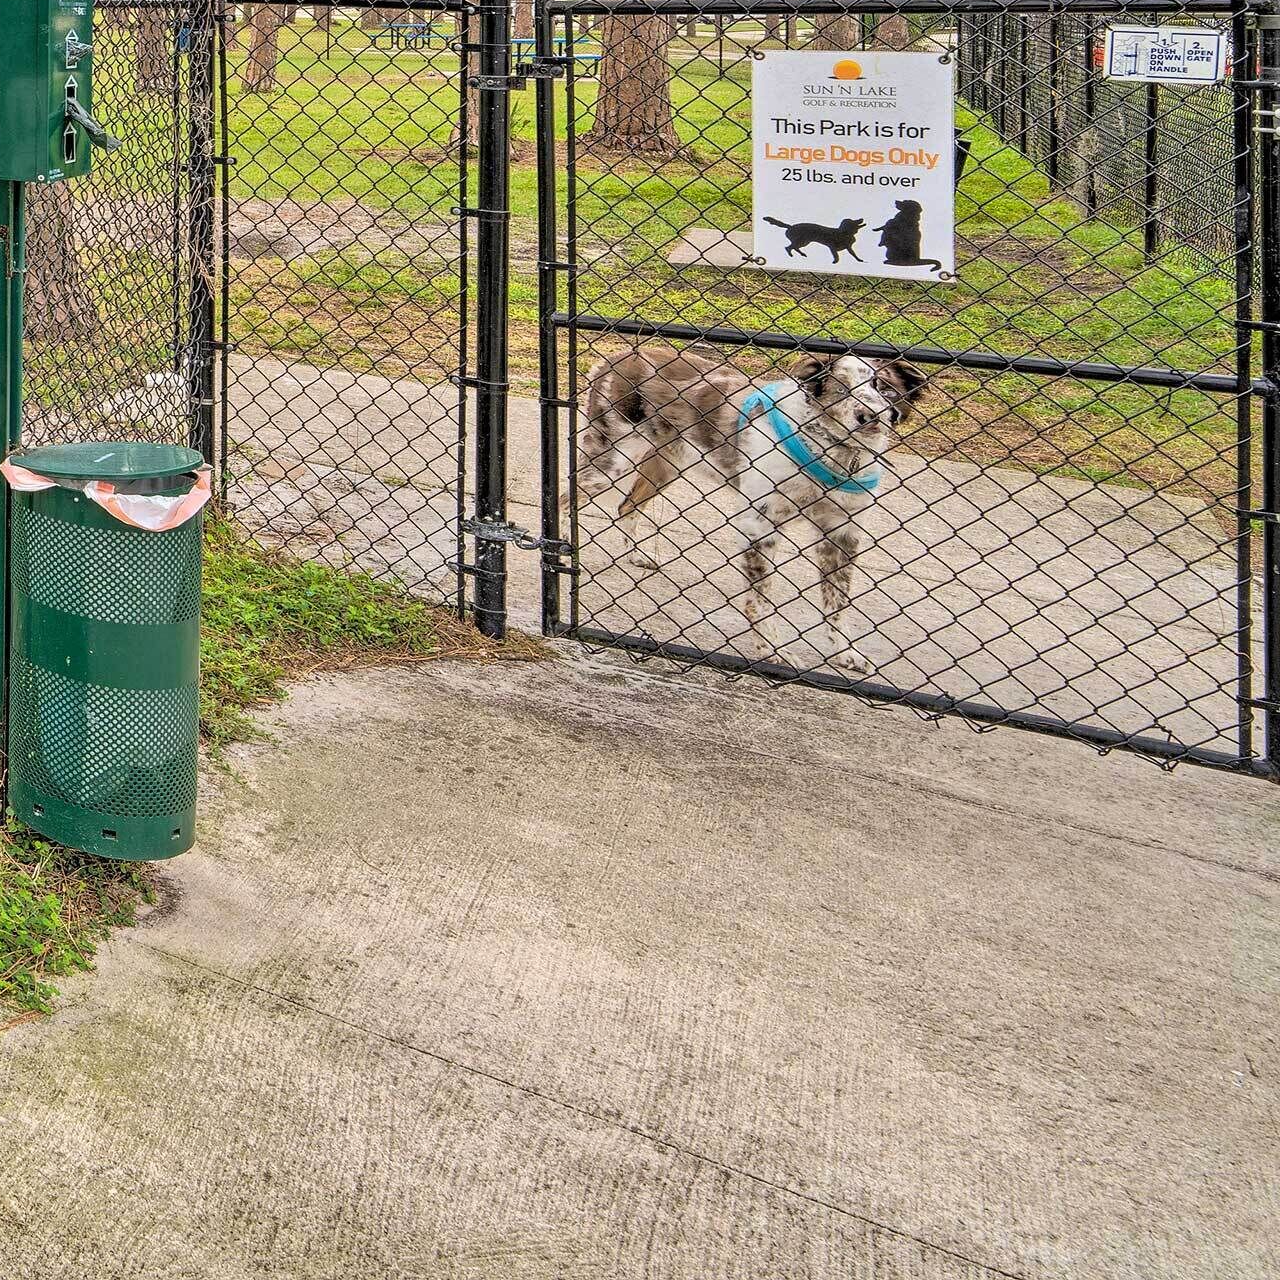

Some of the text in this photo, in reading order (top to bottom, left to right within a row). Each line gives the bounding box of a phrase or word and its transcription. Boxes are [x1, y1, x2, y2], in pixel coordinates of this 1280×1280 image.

[1161, 38, 1170, 46] 1.
[1192, 41, 1204, 50] 2.
[1150, 47, 1177, 55] PUSH
[803, 84, 833, 95] SUN
[859, 86, 897, 97] LAKE
[802, 99, 827, 107] GOLF
[840, 100, 897, 109] RECREATION
[770, 118, 931, 139] This Park is for
[764, 142, 940, 170] Large Dogs Only
[781, 167, 921, 188] 25 lbs. and over
